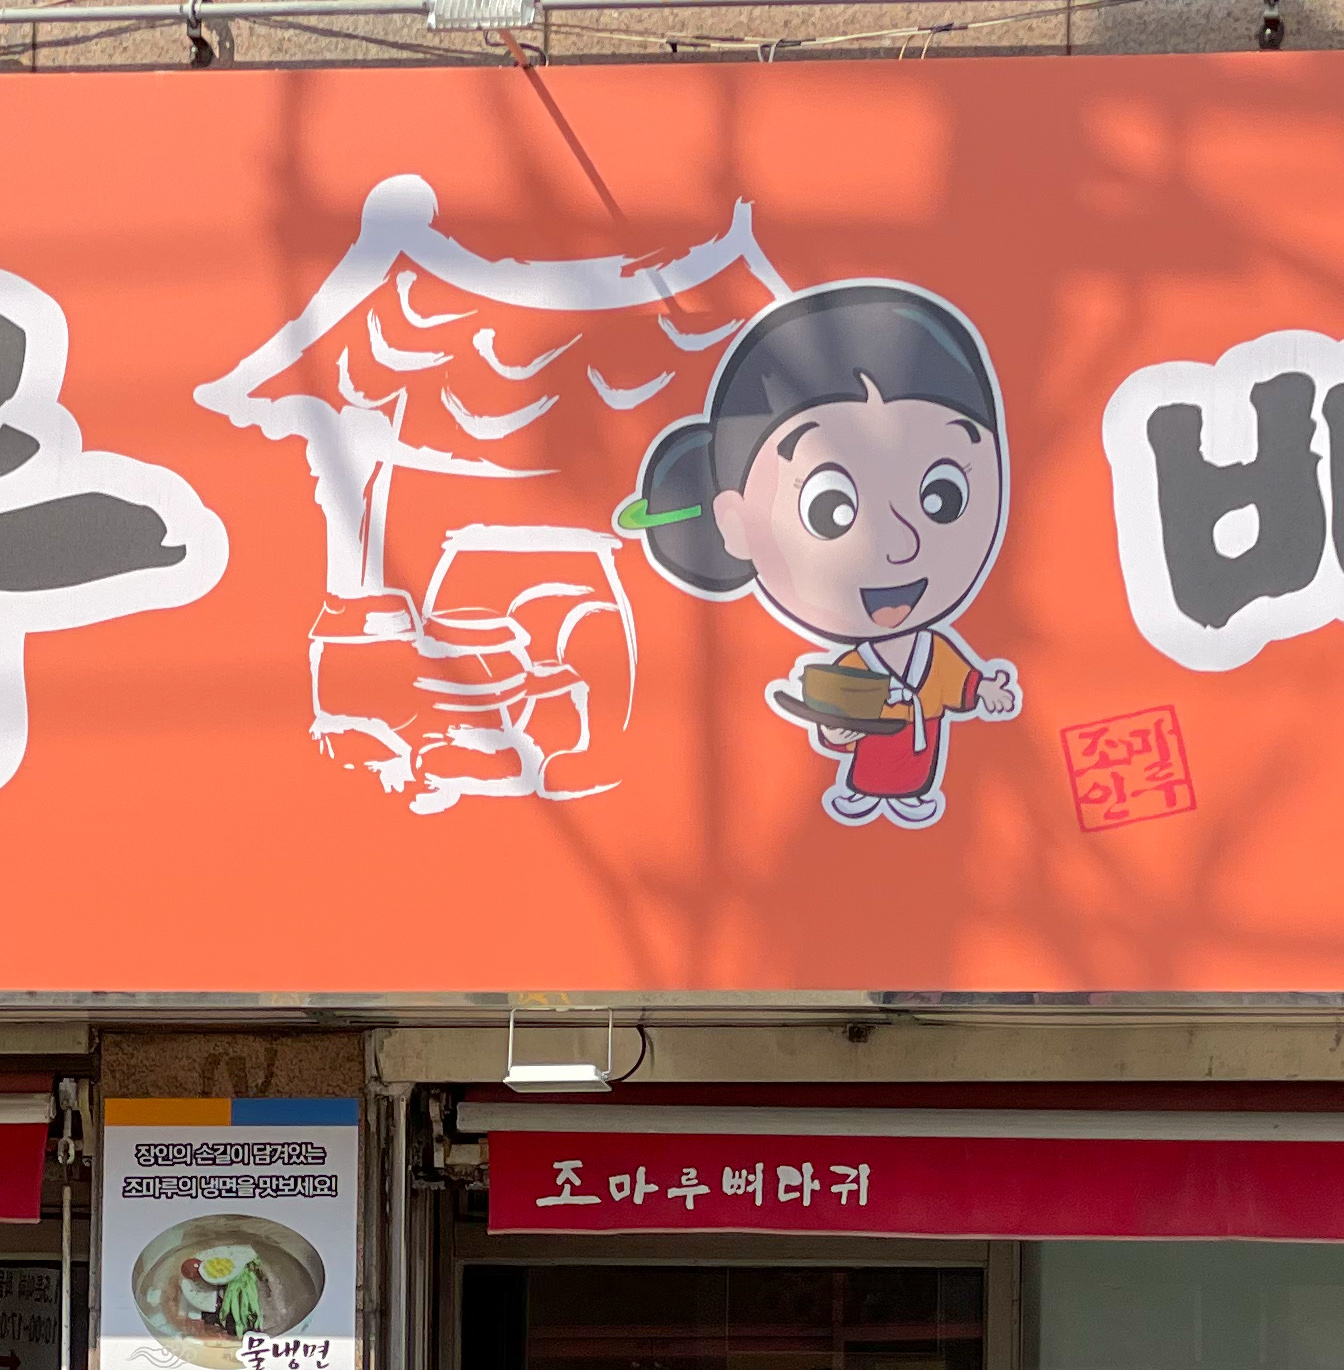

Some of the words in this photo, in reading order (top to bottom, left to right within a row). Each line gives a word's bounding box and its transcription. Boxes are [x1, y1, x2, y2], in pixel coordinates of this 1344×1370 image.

[135, 1143, 193, 1167] 장인의
[194, 1143, 250, 1166] 손길이
[251, 1142, 327, 1166] 담겨있는
[122, 1175, 198, 1199] 조마루의
[199, 1175, 256, 1199] 냉면을
[256, 1175, 338, 1198] 맛보세요!
